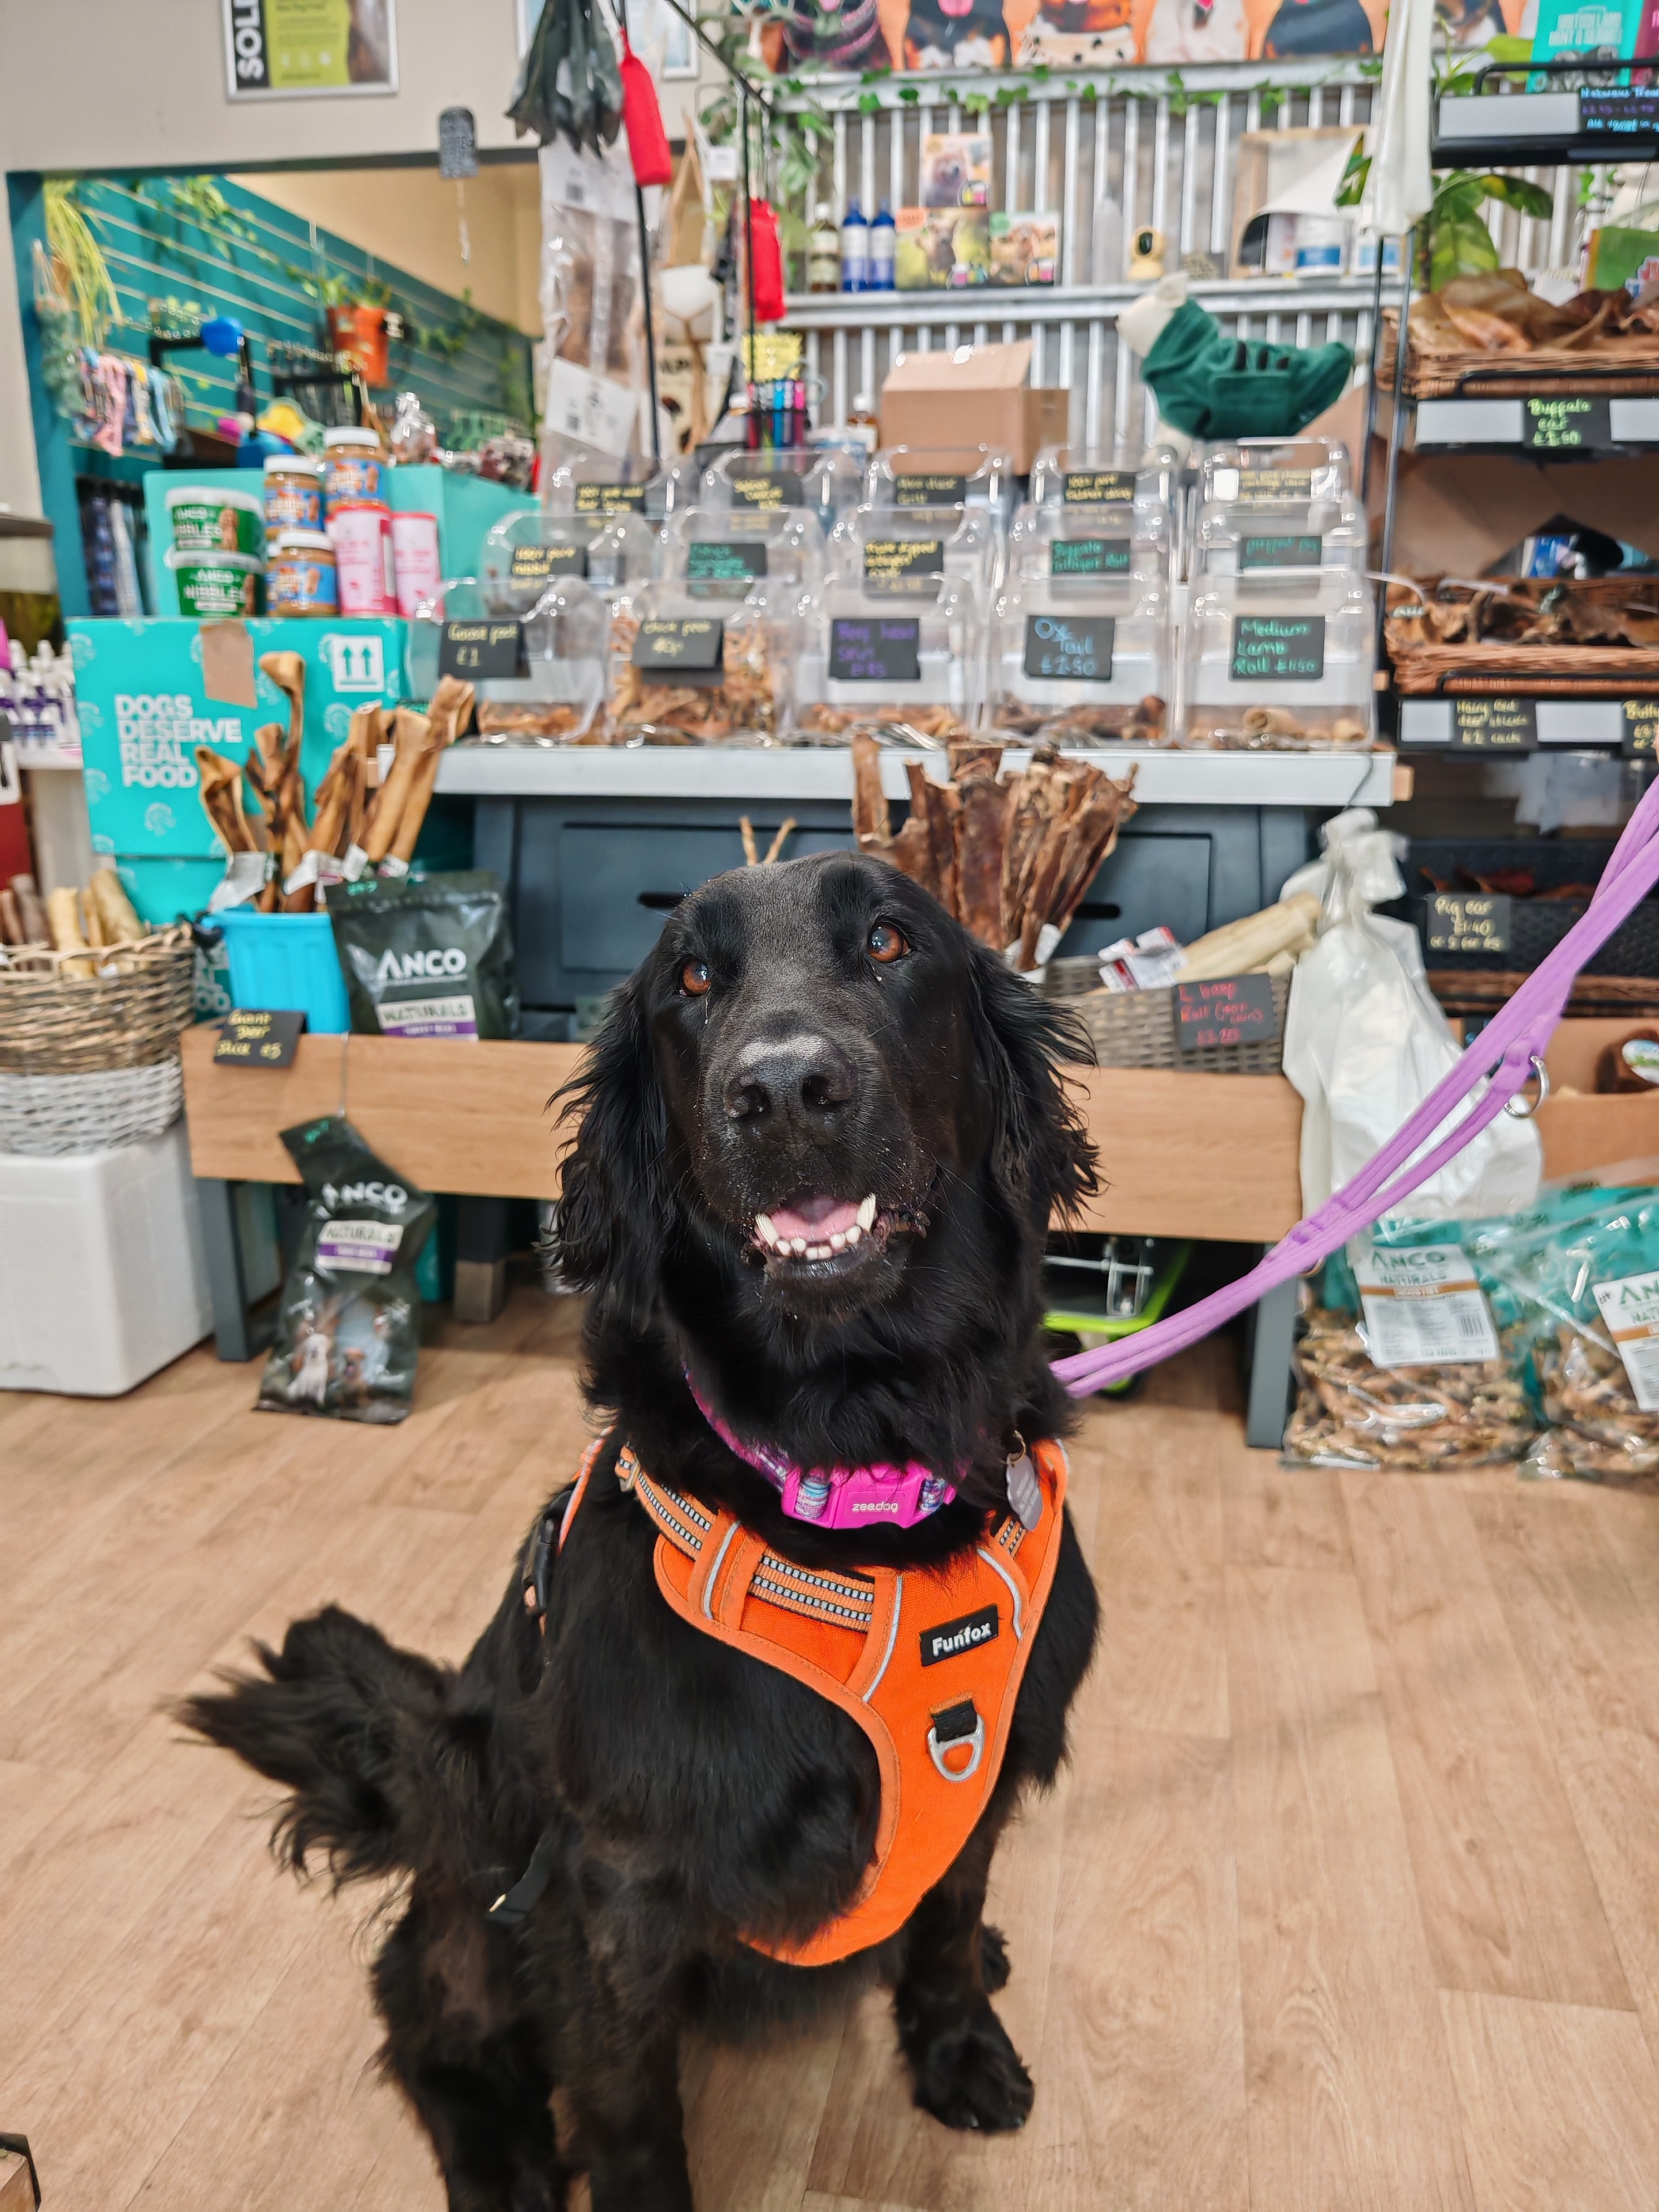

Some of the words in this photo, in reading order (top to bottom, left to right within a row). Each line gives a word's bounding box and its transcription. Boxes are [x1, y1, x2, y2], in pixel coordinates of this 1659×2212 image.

[234, 0, 264, 81] SOL
[1241, 619, 1312, 638] Medium
[1237, 639, 1290, 656] Lamb
[115, 693, 194, 719] DOGS
[118, 717, 243, 743] DESERVE
[120, 741, 191, 767] REAL
[122, 764, 198, 789] FOOD
[376, 948, 467, 981] ANCO
[384, 1003, 468, 1022] NATURALS
[1372, 1251, 1446, 1269] ANCO
[931, 1622, 993, 1658] Funfox
